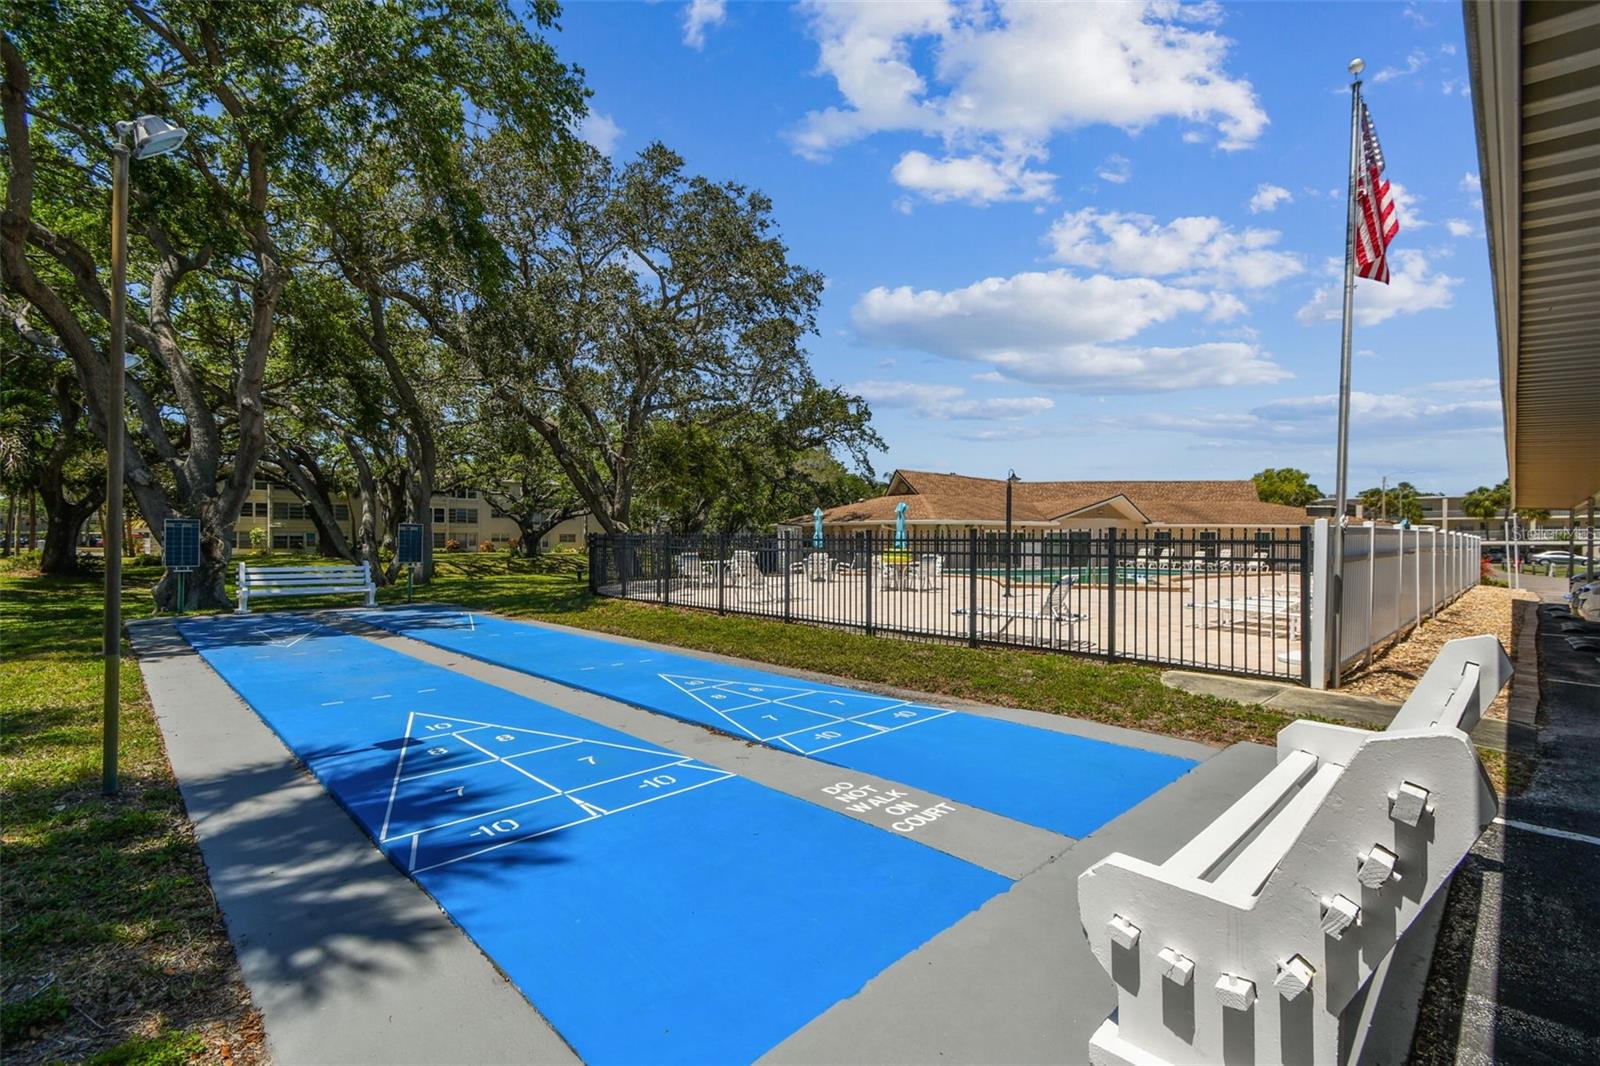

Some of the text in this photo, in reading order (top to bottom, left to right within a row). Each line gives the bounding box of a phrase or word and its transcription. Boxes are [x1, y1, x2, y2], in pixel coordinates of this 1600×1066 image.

[425, 721, 452, 732] 10
[577, 756, 597, 766] 7
[445, 785, 465, 797] 7
[821, 782, 854, 795] DO
[835, 784, 878, 803] NOT
[845, 789, 908, 813] WALK
[885, 801, 919, 815] ON
[891, 802, 957, 832] COURT
